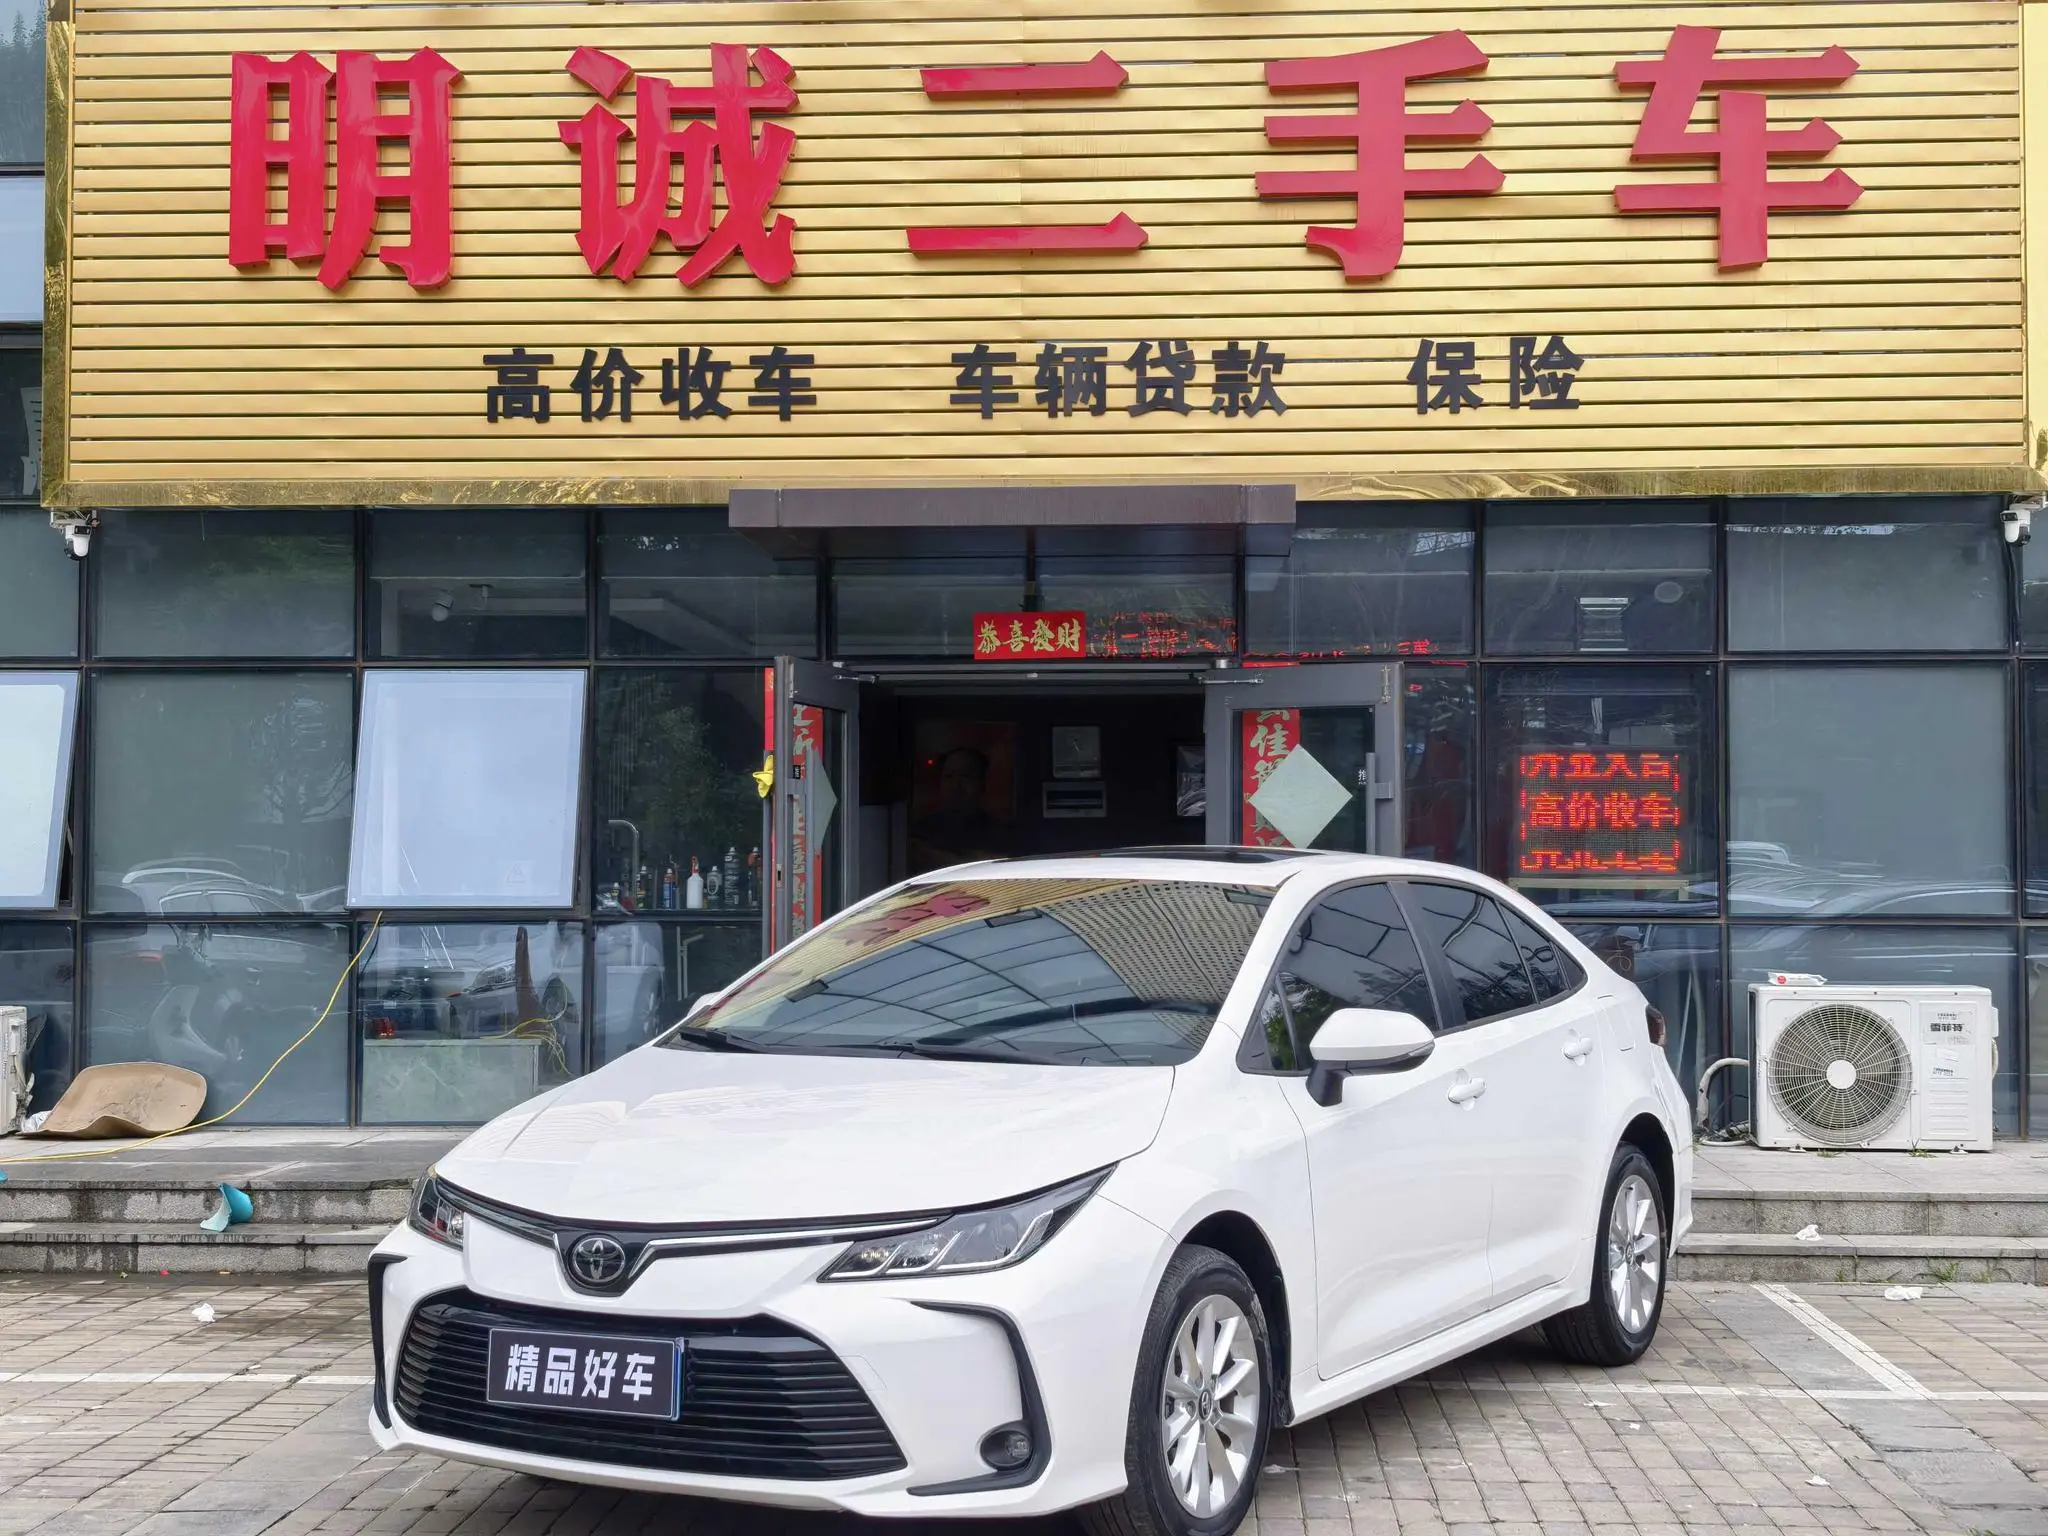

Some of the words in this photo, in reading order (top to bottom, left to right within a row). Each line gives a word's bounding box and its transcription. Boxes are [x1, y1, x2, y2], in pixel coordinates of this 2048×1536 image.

[229, 24, 1865, 291] 明诚二手车
[483, 345, 818, 423] 高价收车
[949, 340, 1288, 420] 车辆贷款
[1407, 335, 1585, 415] 保险
[1528, 791, 1675, 829] 高价收车
[504, 1343, 656, 1401] 精品好车
